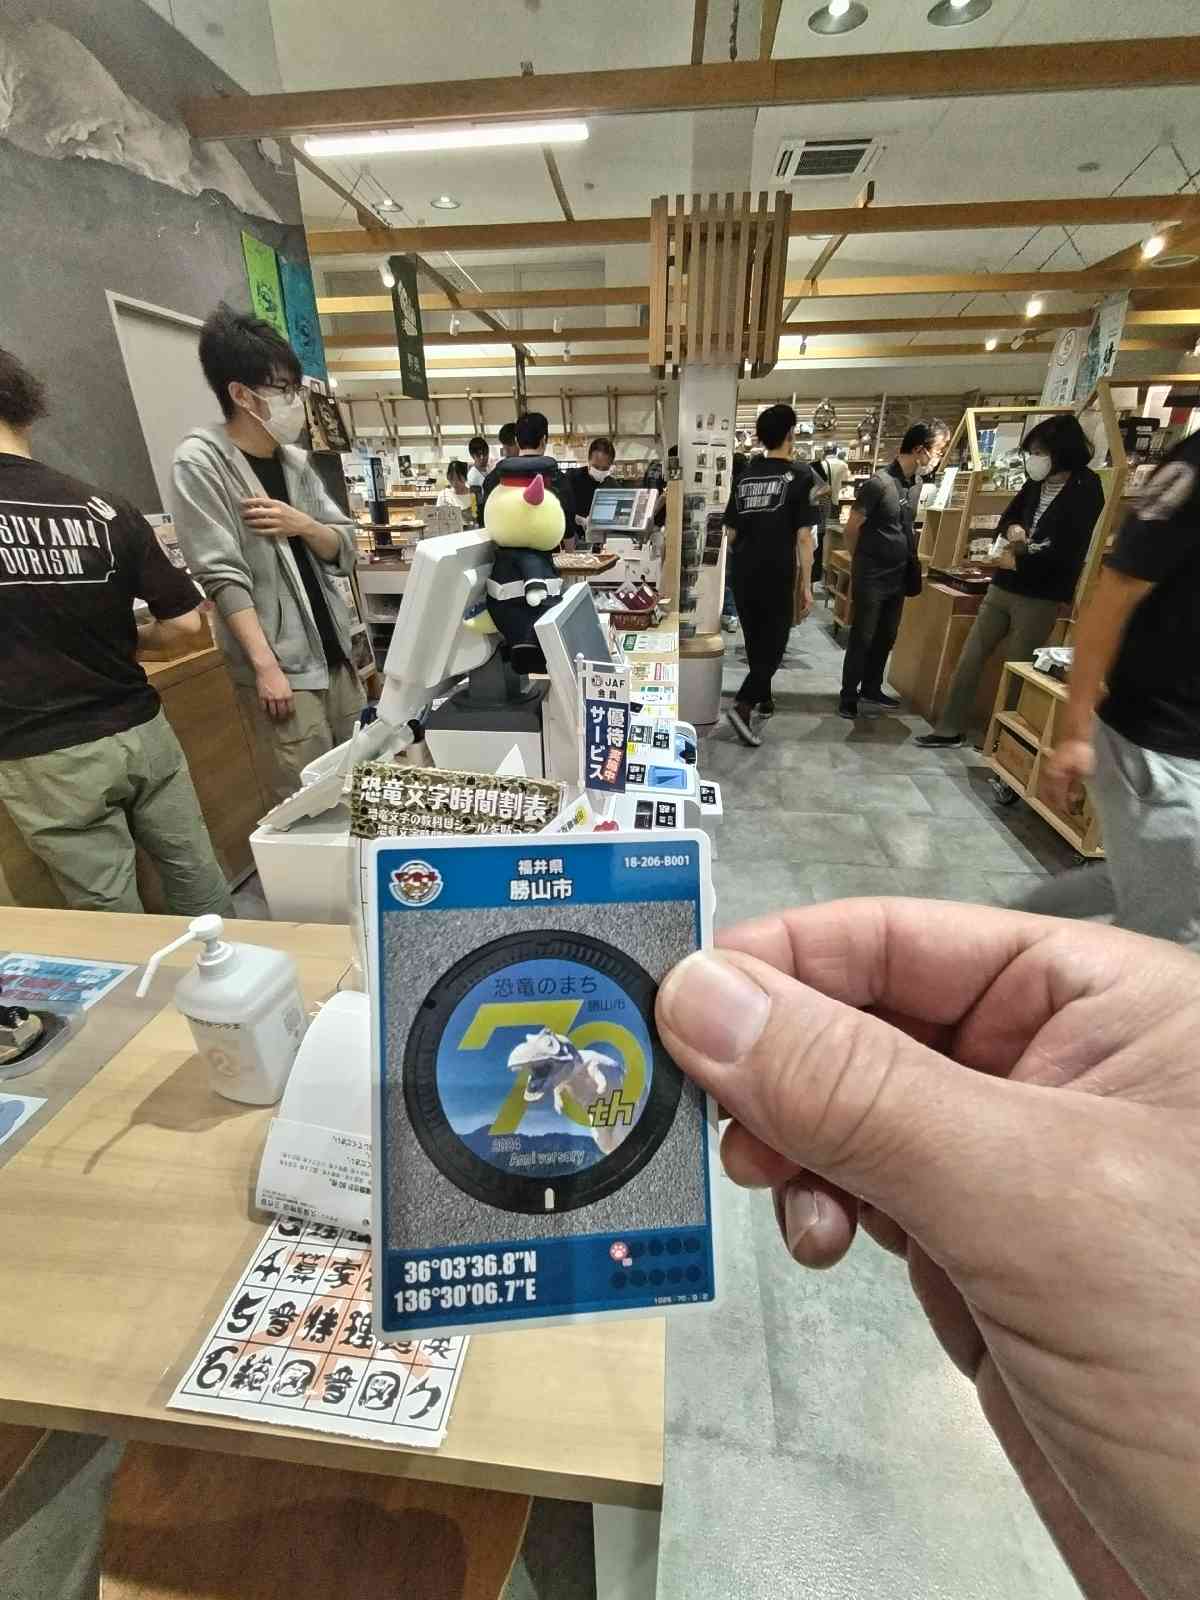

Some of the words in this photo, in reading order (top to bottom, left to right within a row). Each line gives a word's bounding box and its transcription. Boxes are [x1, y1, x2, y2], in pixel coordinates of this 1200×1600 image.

[605, 679, 625, 689] JAF
[589, 705, 606, 782] サービス
[360, 776, 547, 824] 恐竜文字時間割表
[518, 858, 564, 876] 福井県
[624, 854, 690, 868] 18-206-B001
[509, 878, 573, 900] 勝山市
[494, 975, 598, 998] 恐竜のまち
[227, 1291, 267, 1333] 5
[197, 1345, 239, 1389] 6
